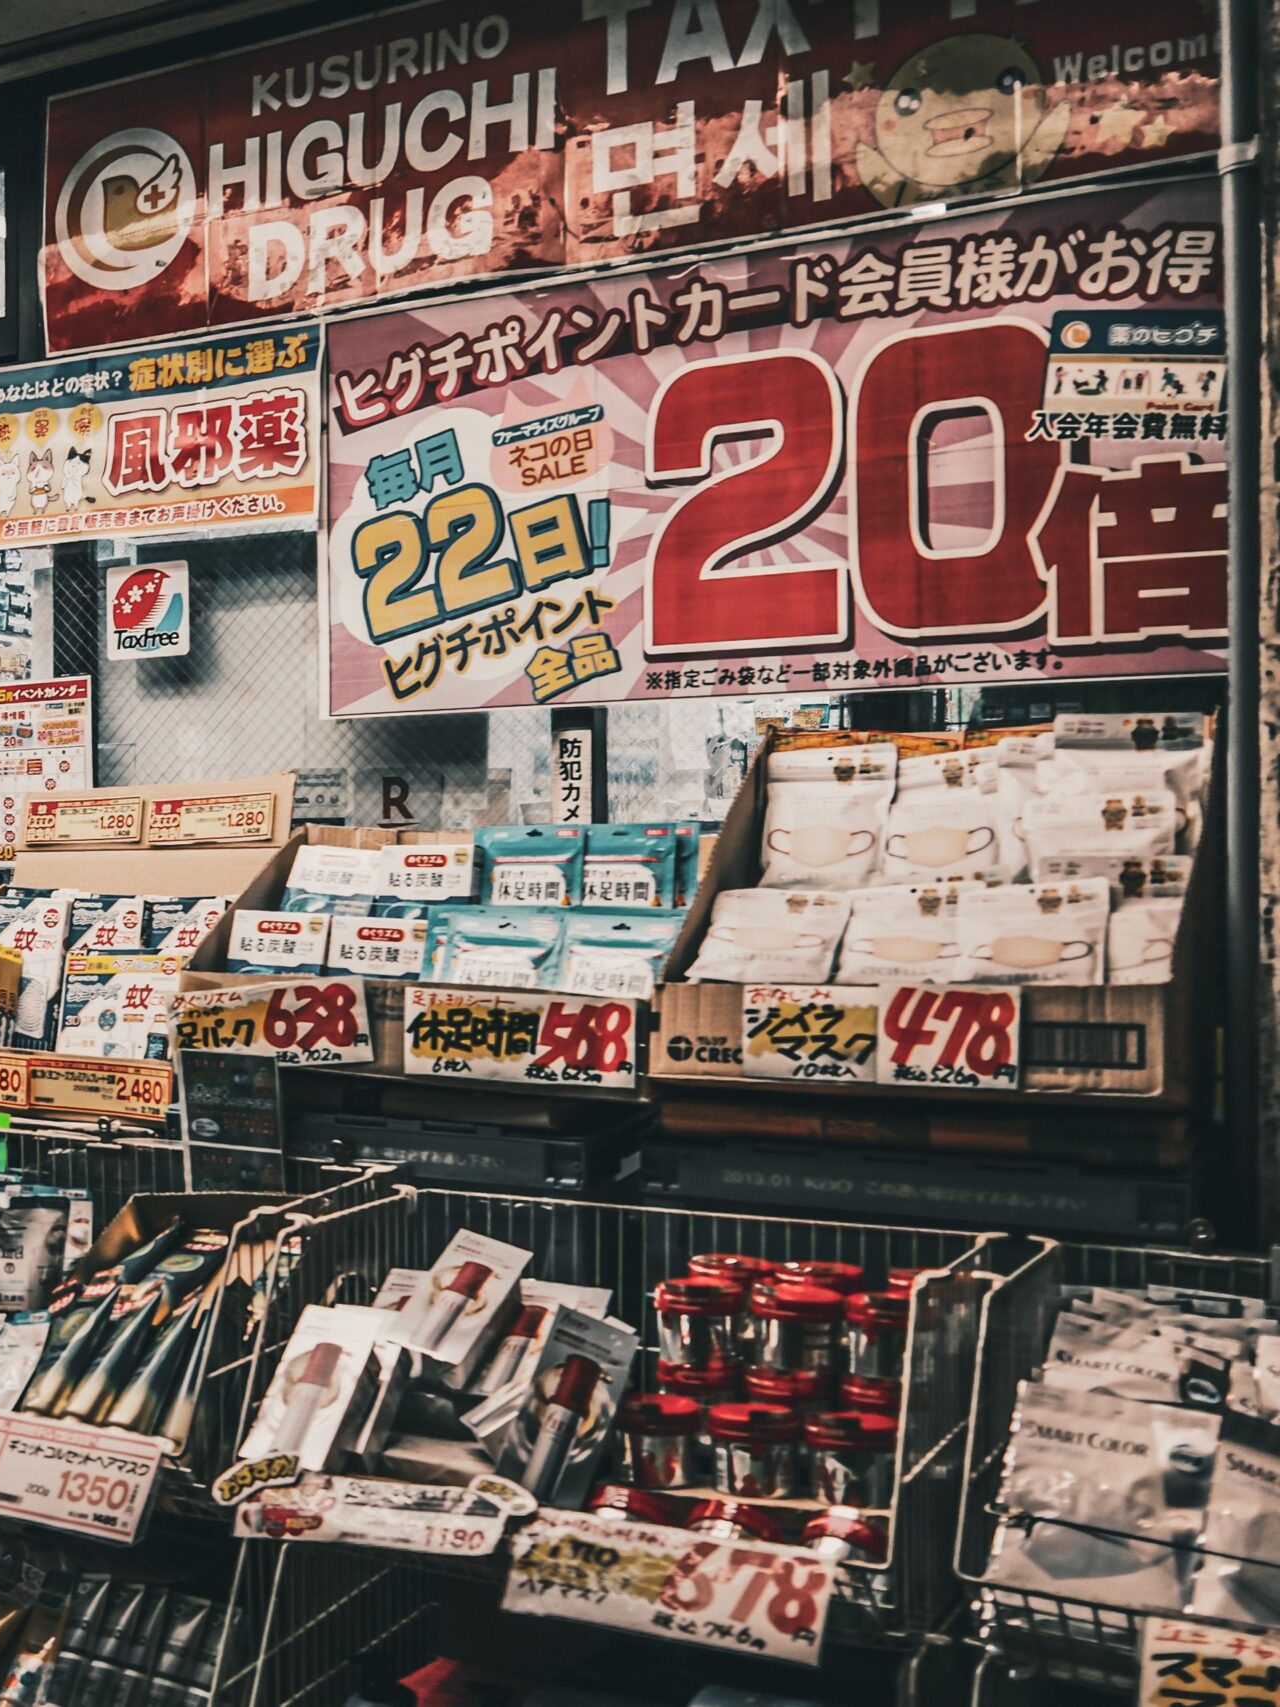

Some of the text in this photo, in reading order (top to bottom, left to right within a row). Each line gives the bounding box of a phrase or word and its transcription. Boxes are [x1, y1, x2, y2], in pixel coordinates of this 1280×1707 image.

[251, 15, 510, 116] KUSURINO
[582, 0, 813, 96] TAX
[208, 68, 558, 220] HIGUCHI
[593, 62, 832, 237] 면세
[248, 176, 494, 301] DRUG
[338, 228, 1217, 424] ヒグチポイントカード会員様がお得
[129, 333, 308, 392] 症状別に選ぶ
[106, 391, 304, 491] 風邪薬
[508, 429, 593, 468] ネコの日
[365, 428, 466, 511] 毎月
[521, 455, 588, 487] SALE
[113, 627, 180, 650] TaxFree
[384, 590, 614, 700] ヒグチポイント
[526, 633, 622, 704] 全品
[381, 776, 416, 819] R
[558, 738, 583, 822] 防犯カメ
[388, 871, 444, 889] 貼る炭酸
[496, 881, 561, 901] 休足時間
[583, 881, 649, 901] 休足時間
[239, 935, 295, 955] 貼る炭酸
[258, 921, 302, 934] めぐりズム
[358, 927, 404, 941] めぐりズム
[339, 943, 400, 963] 貼る炭酸
[411, 991, 516, 1008] 足すっきりシート
[571, 970, 649, 992] 休足時間
[748, 988, 833, 1004] おなじみ
[177, 1014, 255, 1049] 足パック
[406, 1007, 543, 1057] 休足時間
[771, 1034, 877, 1066] マスク
[1021, 1421, 1149, 1456] SMART COLOR
[58, 1470, 130, 1511] 1350
